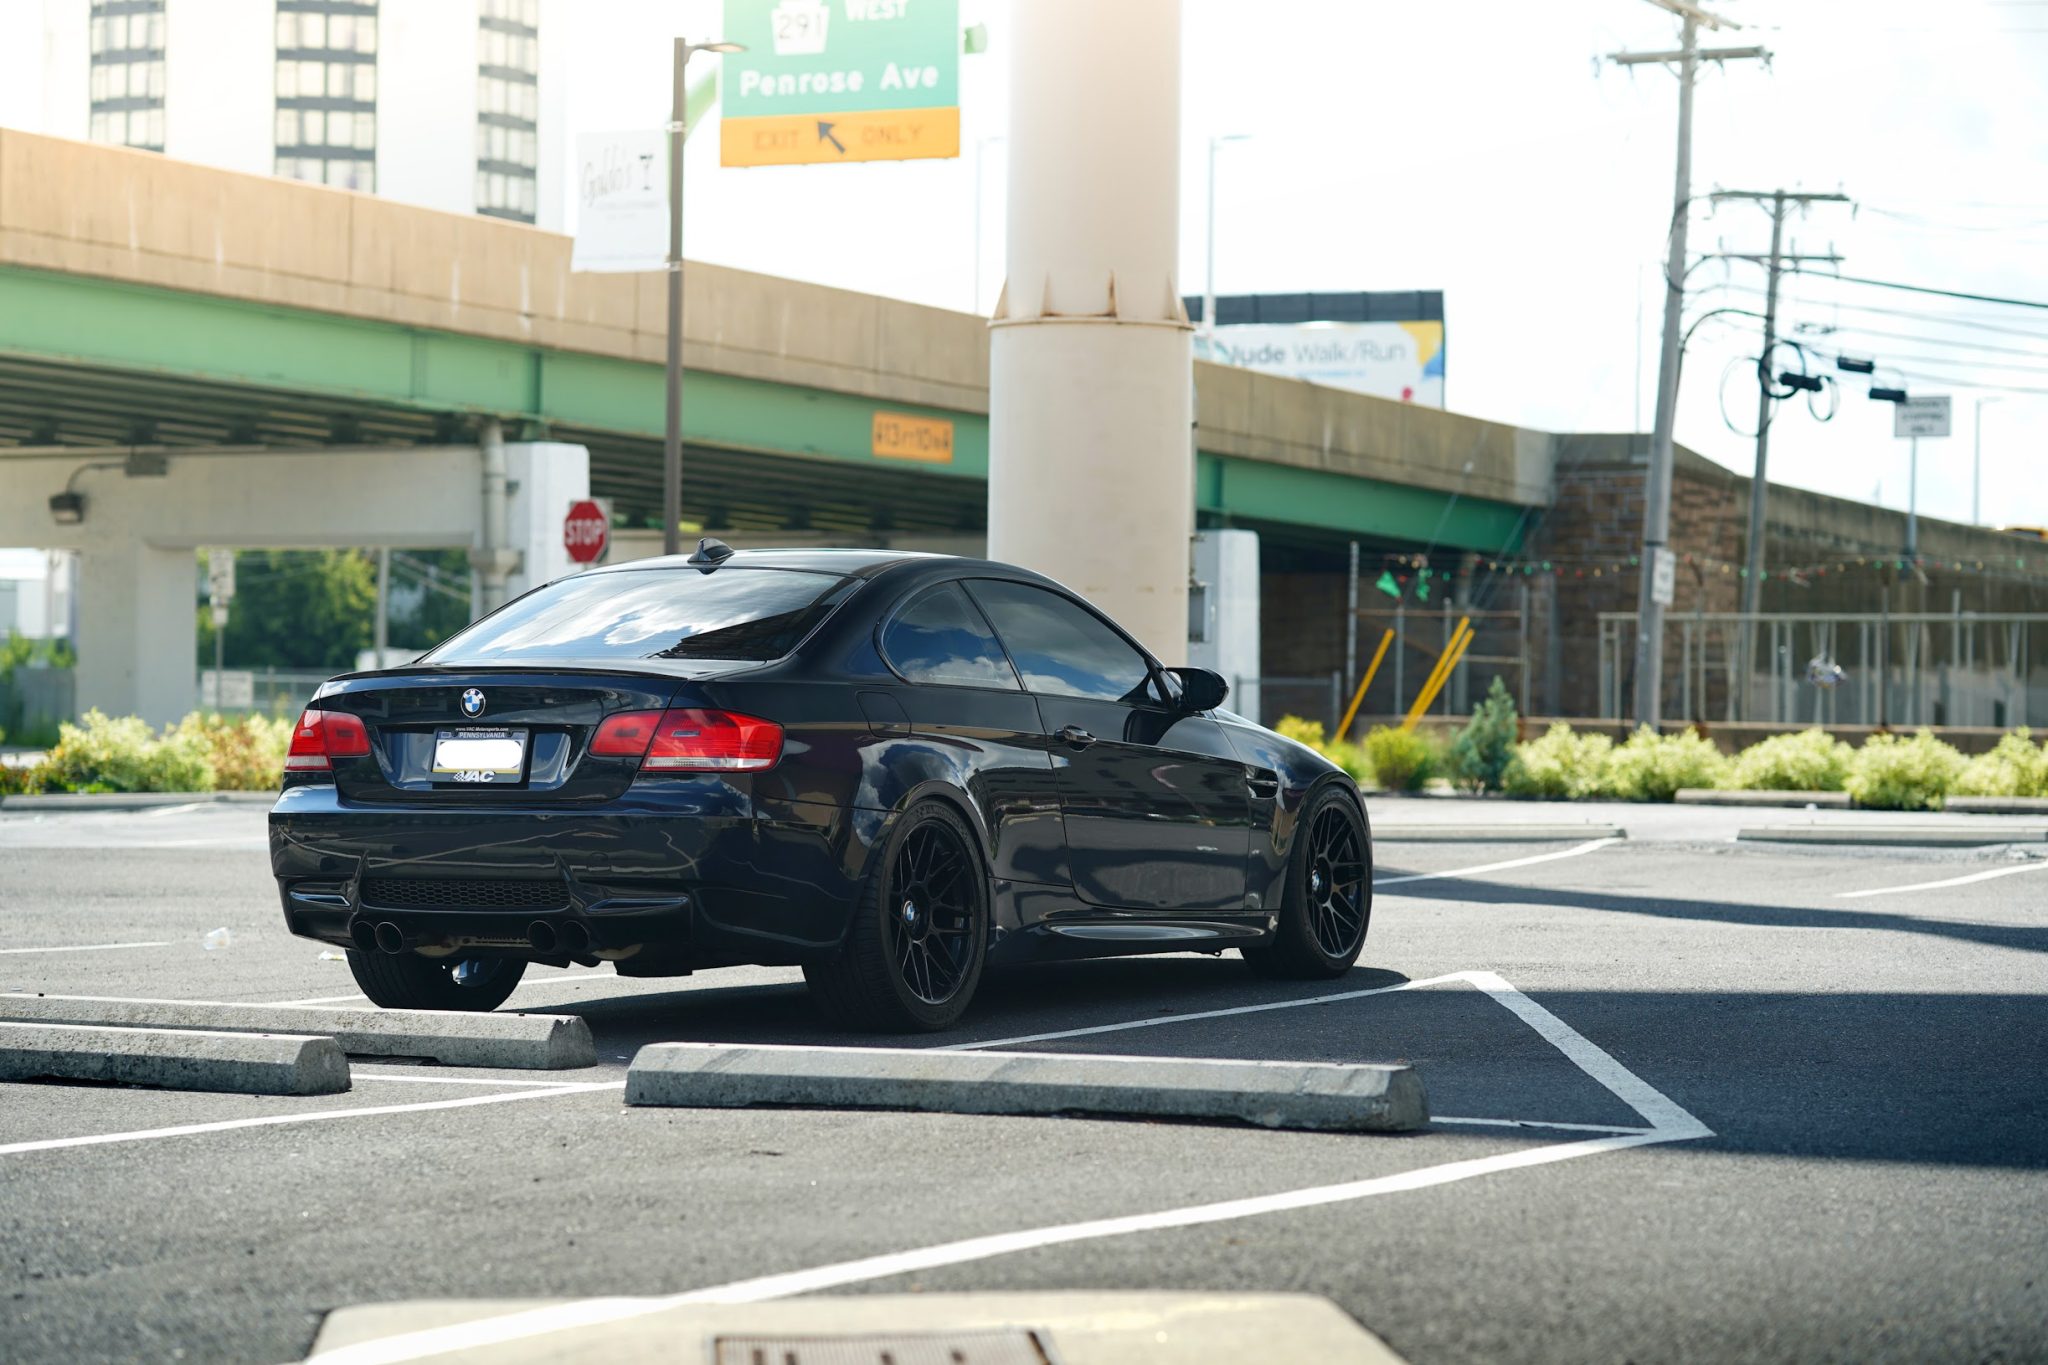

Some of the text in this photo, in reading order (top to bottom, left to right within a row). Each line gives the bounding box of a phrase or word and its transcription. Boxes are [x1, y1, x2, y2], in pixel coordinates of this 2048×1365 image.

[845, 0, 909, 21] WEST
[778, 13, 822, 41] 291
[739, 62, 939, 98] Penrose Ave
[754, 123, 923, 151] EXIT ONLY
[566, 518, 604, 546] STOP
[459, 731, 506, 739] PENNSYLVANIA
[454, 770, 495, 782] VAC
